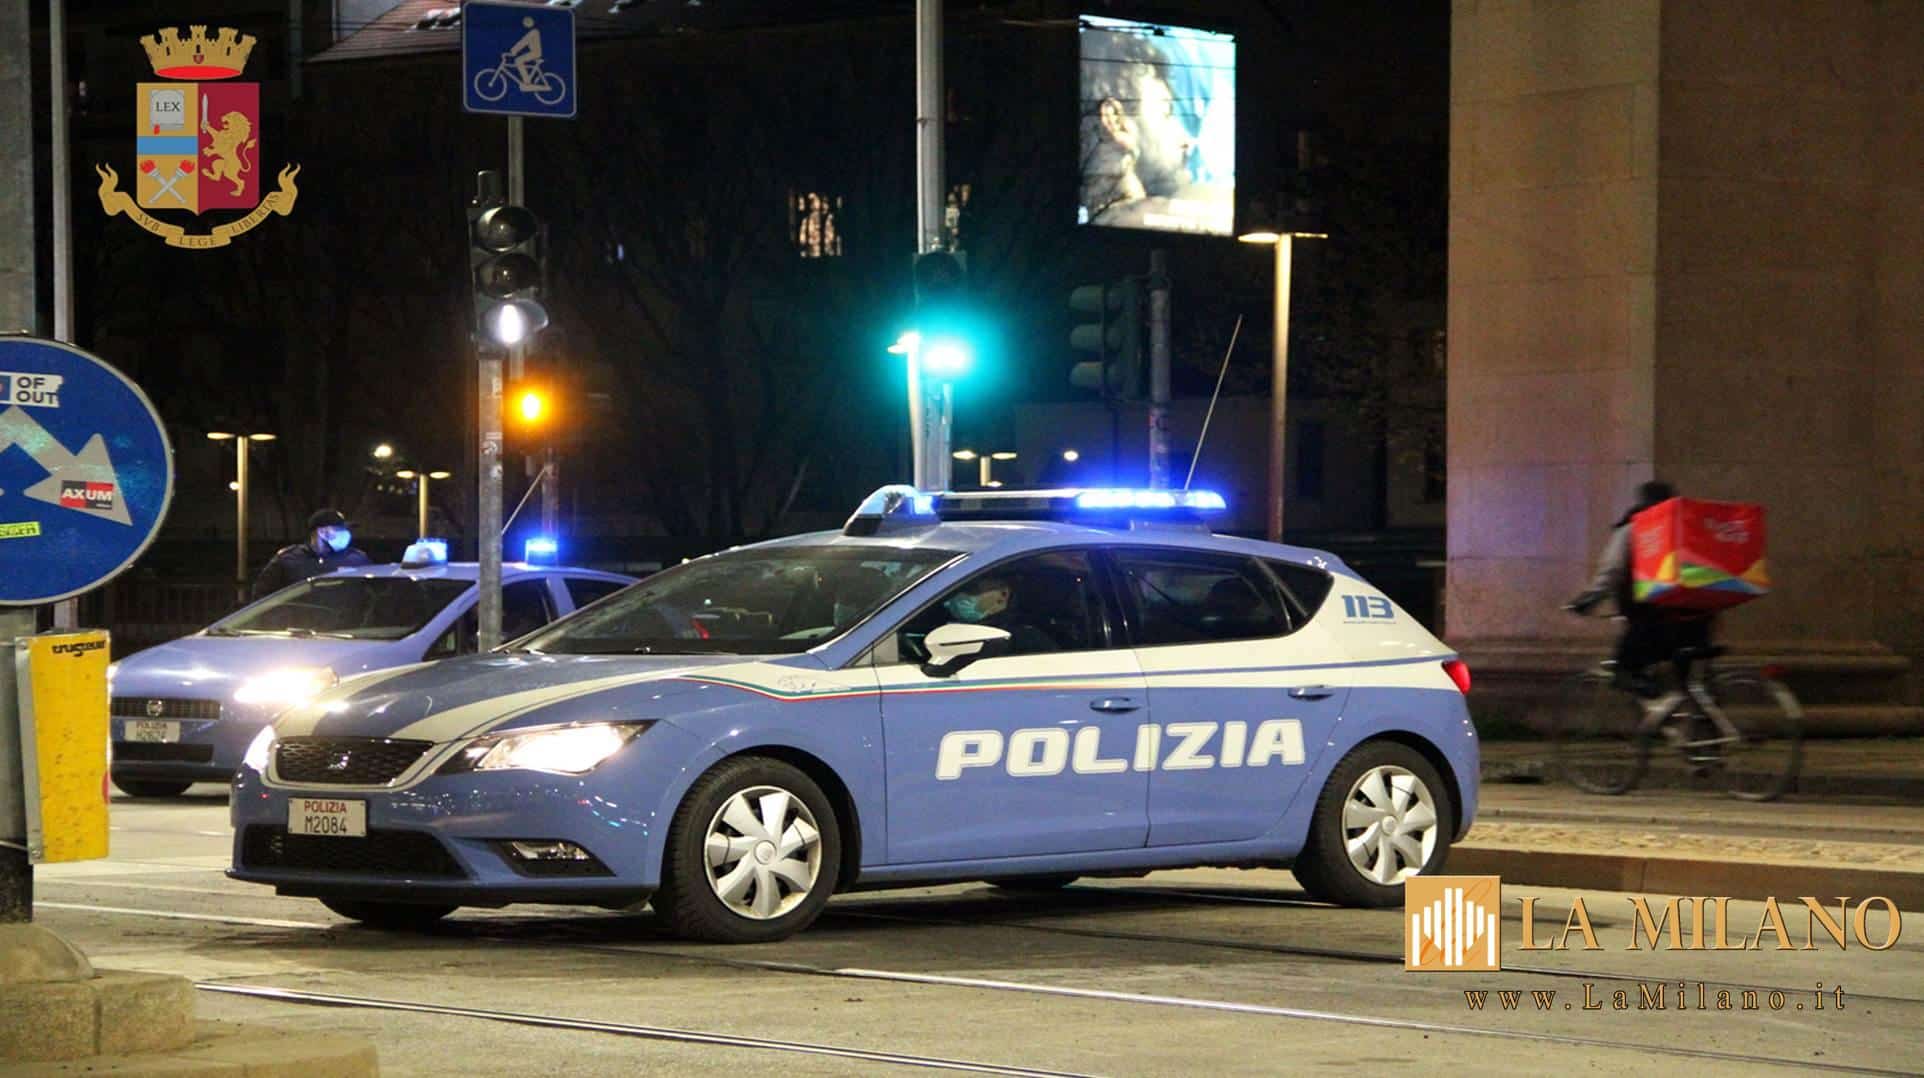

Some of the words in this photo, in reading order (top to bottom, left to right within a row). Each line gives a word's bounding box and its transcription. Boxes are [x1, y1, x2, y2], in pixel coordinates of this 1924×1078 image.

[17, 376, 46, 389] OF
[16, 390, 57, 404] OUT
[61, 487, 112, 501] AXUM
[1341, 595, 1394, 618] 113
[935, 719, 1305, 781] POLIZIA
[304, 800, 347, 813] POLIZIA
[305, 816, 347, 834] M2084
